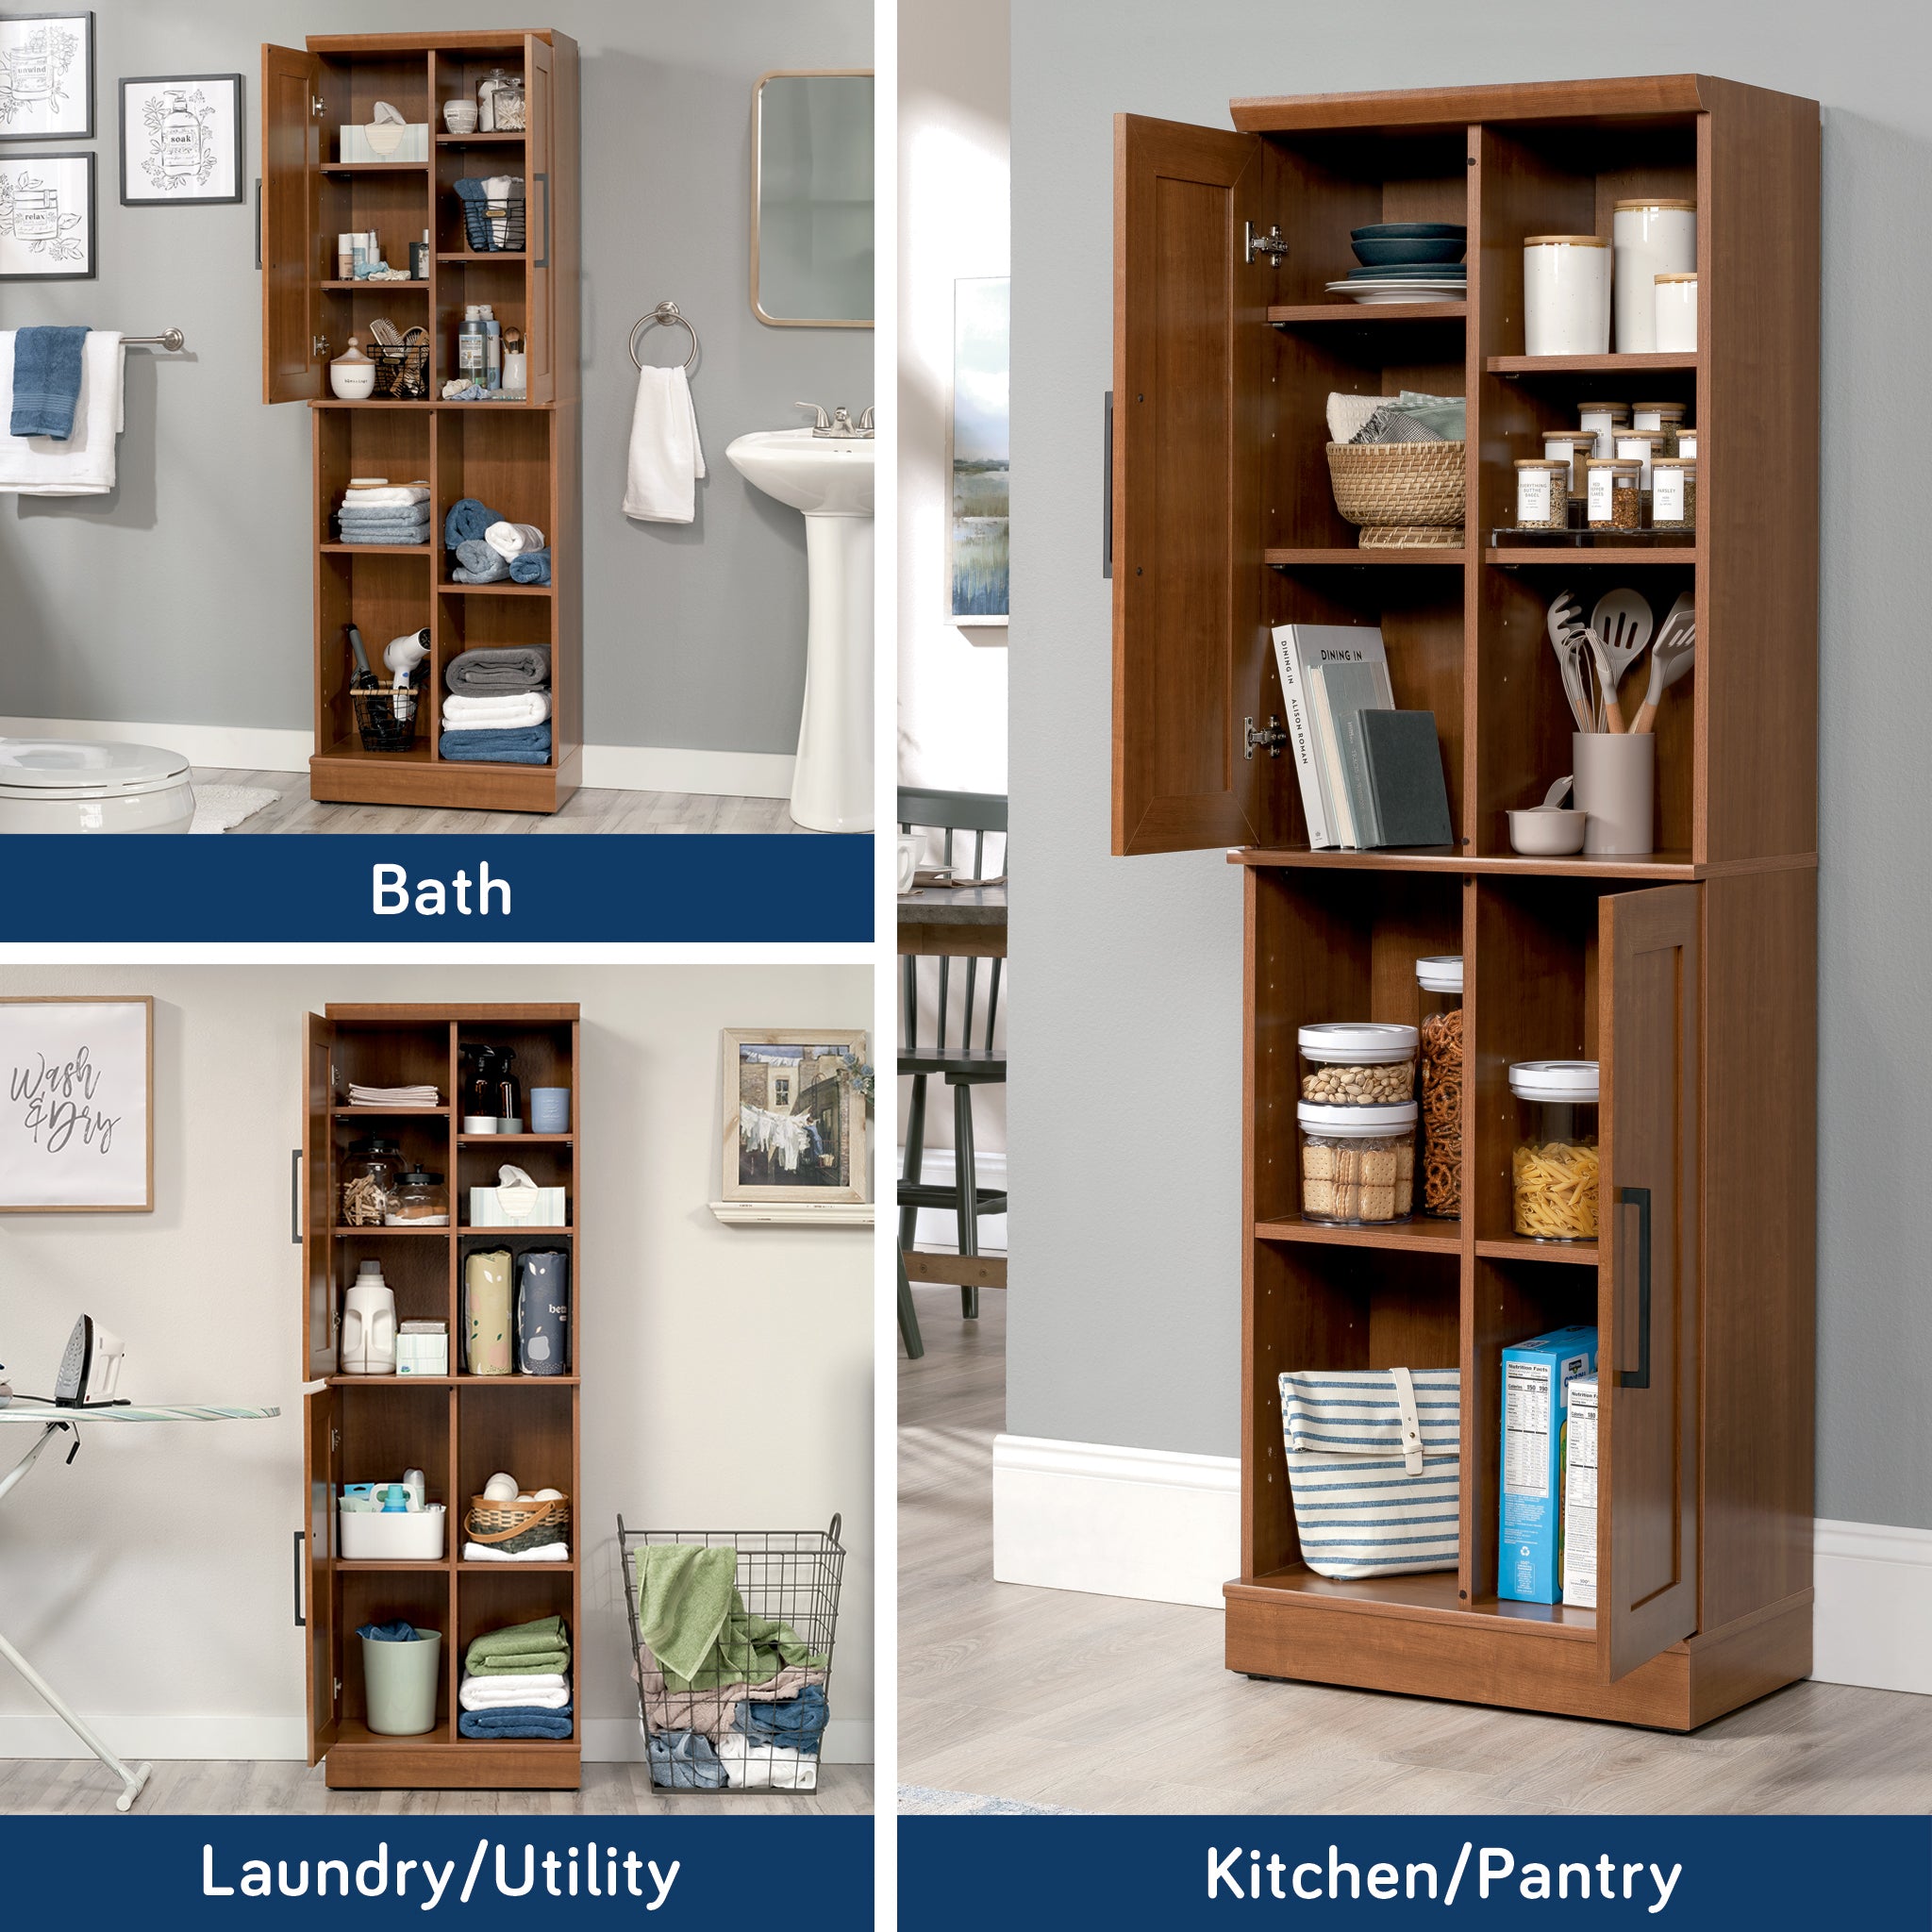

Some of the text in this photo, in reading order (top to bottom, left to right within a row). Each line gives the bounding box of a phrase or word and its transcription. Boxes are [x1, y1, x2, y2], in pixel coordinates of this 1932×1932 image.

[1280, 641, 1292, 673] DINING
[1321, 649, 1363, 661] DINING IN
[1291, 698, 1308, 764] ALISON ROMAN
[10, 1045, 101, 1102] Wash
